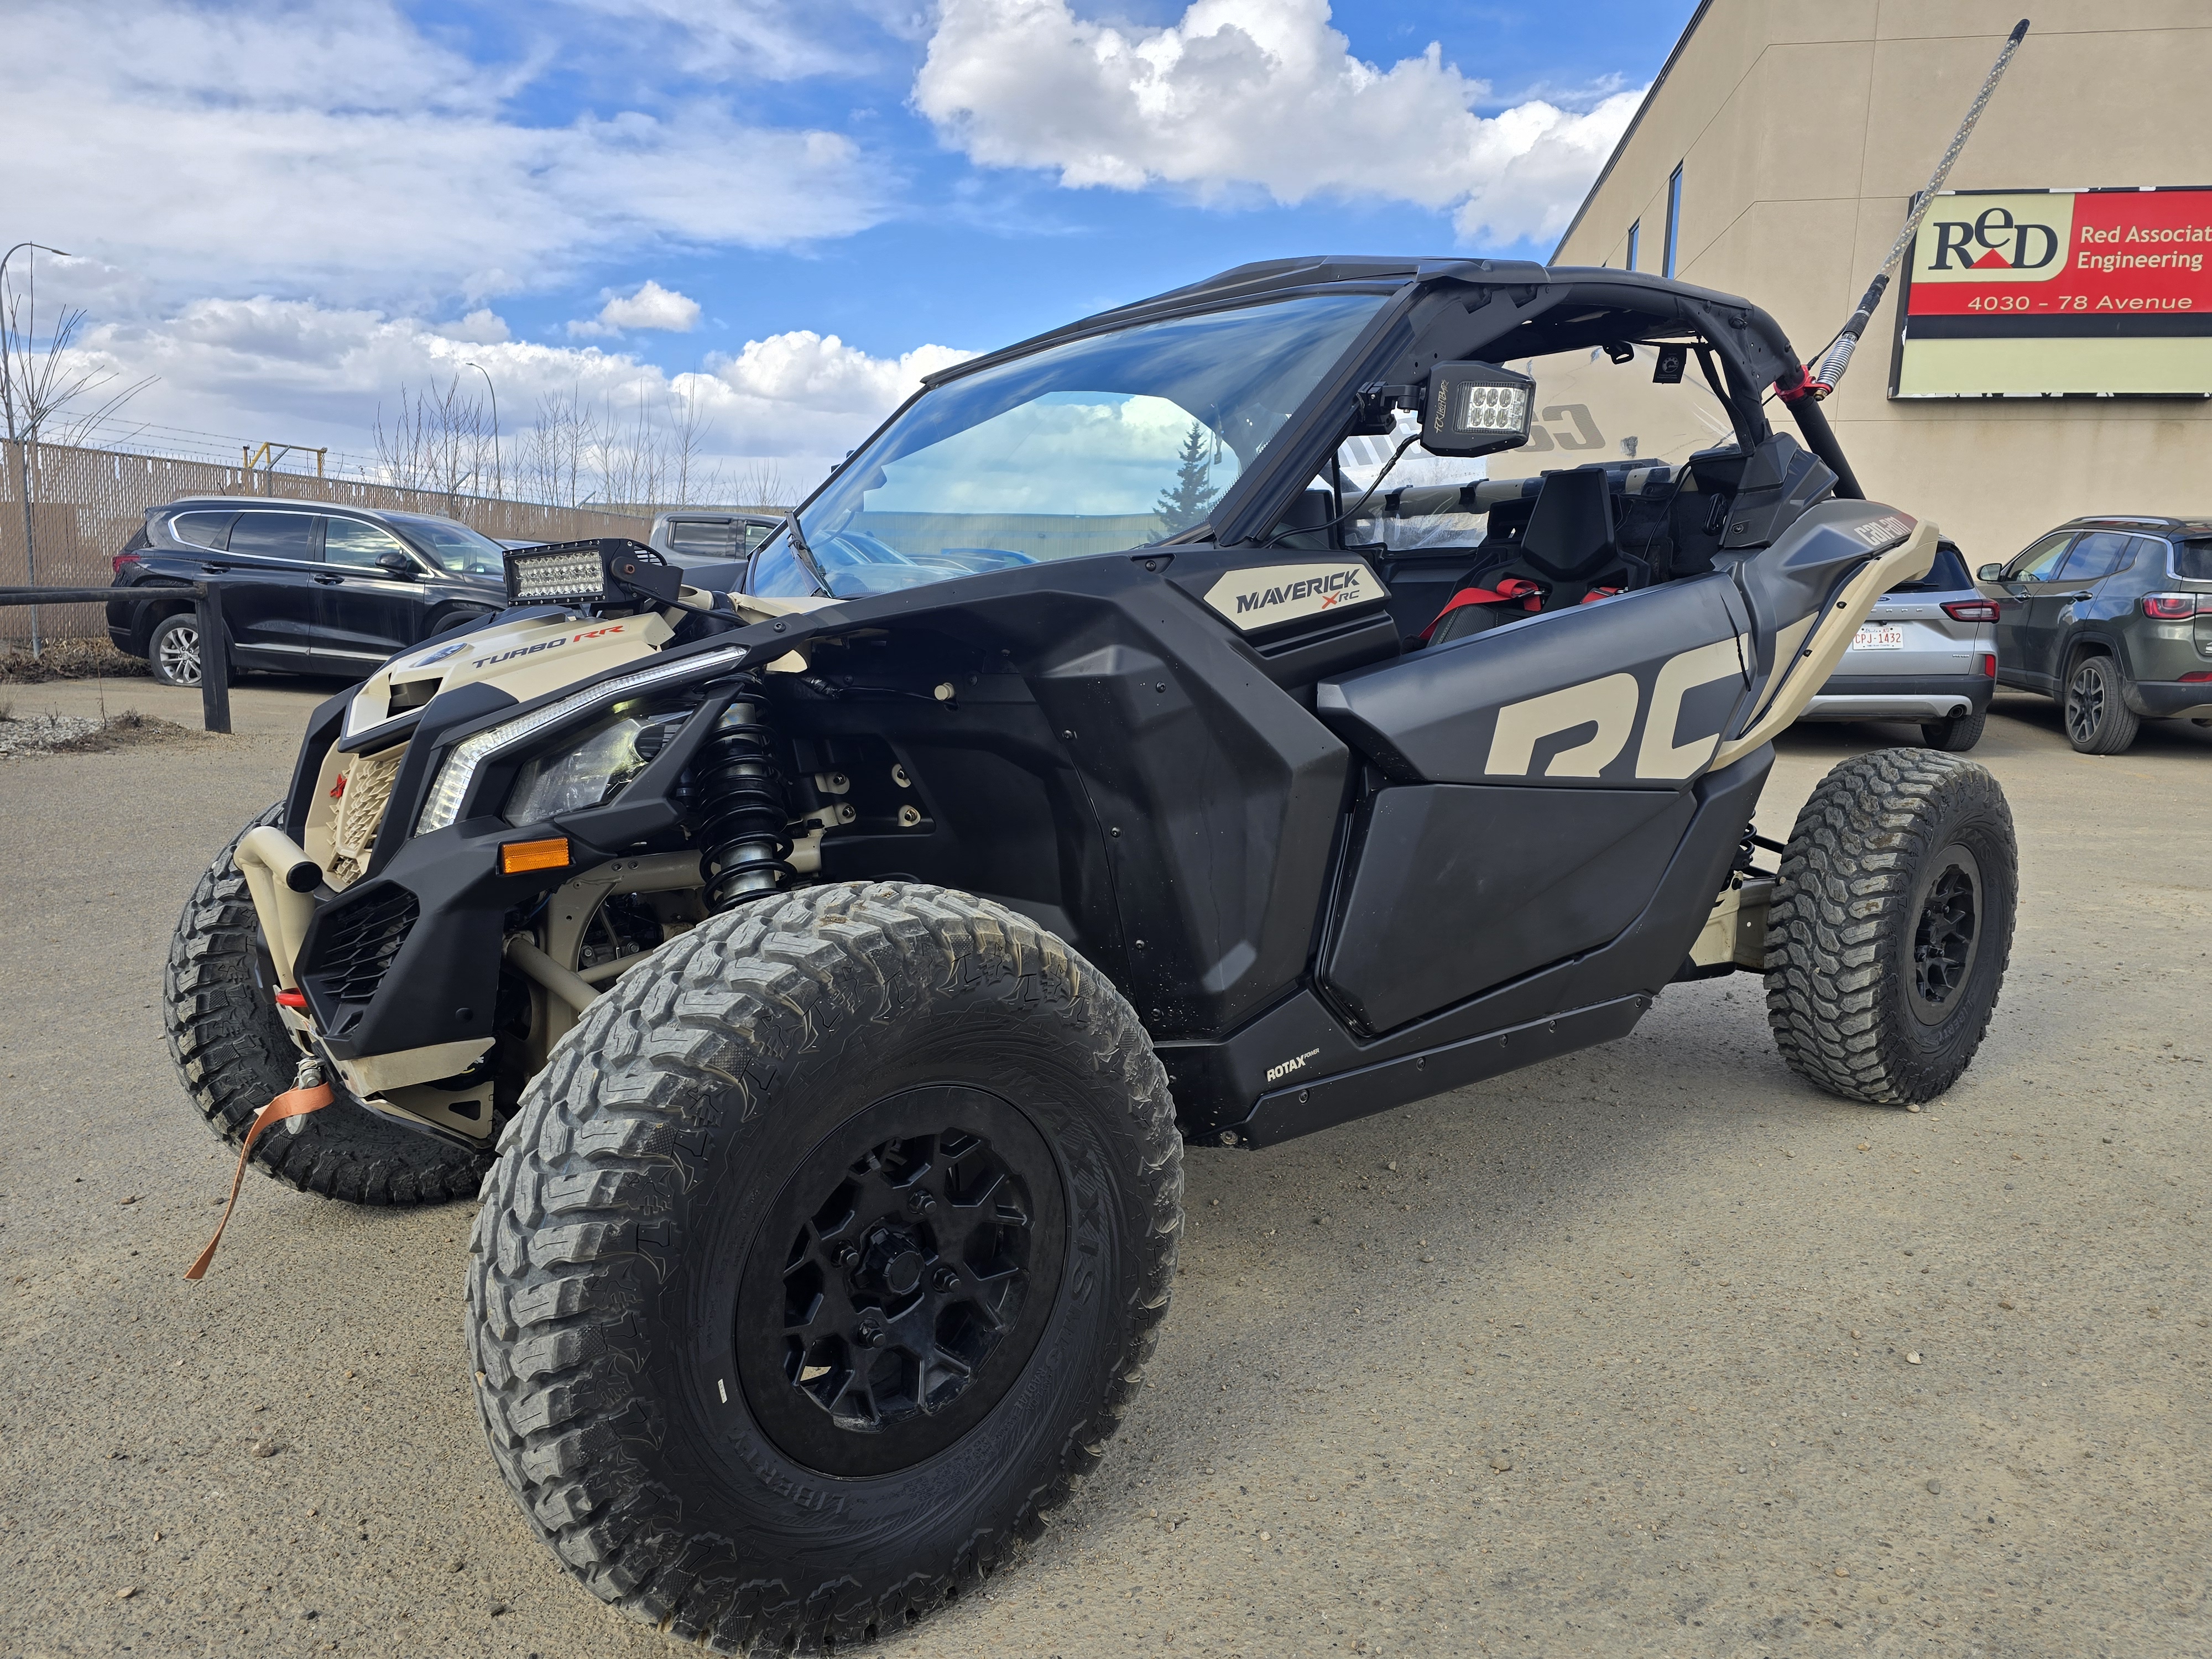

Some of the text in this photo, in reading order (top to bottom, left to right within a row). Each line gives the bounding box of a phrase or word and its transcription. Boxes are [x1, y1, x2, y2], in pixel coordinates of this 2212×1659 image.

[2080, 225, 2212, 243] Red Associat
[2077, 251, 2203, 273] Engineering
[1968, 296, 2030, 310] 4030
[2058, 295, 2088, 310] 78
[2095, 295, 2193, 310] Avenue
[1235, 568, 1360, 614] MAVERICK
[472, 625, 625, 669] TURBO RR
[1855, 633, 1901, 644] CPJ-1432
[1484, 672, 1749, 780] RC
[1266, 1047, 1320, 1082] ROTAX POWER
[1013, 1366, 1048, 1410] RADIAL
[726, 1432, 847, 1515] LIBERTY
